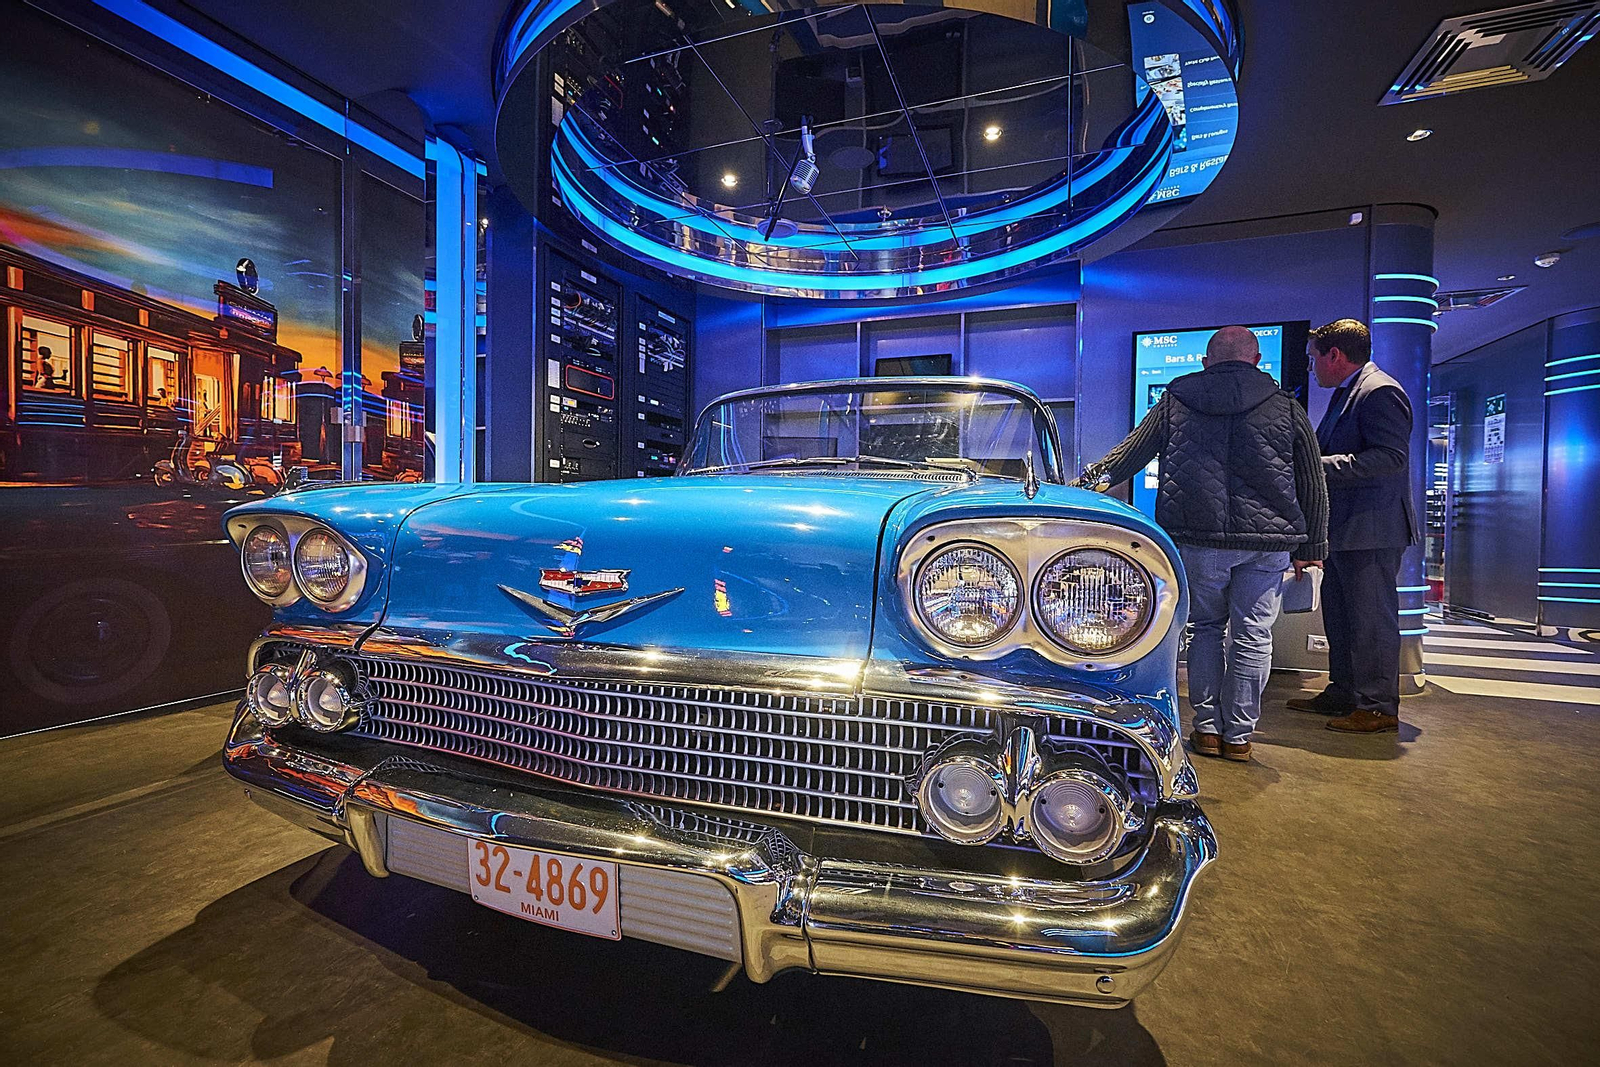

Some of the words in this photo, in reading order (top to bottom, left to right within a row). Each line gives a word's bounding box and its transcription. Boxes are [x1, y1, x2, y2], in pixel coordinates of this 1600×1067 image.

[1253, 329, 1273, 337] DECK
[1153, 335, 1178, 345] MSC
[1165, 354, 1186, 363] Bars
[1186, 353, 1195, 362] &
[475, 841, 609, 915] 32-4869
[520, 901, 559, 922] MIAMI
